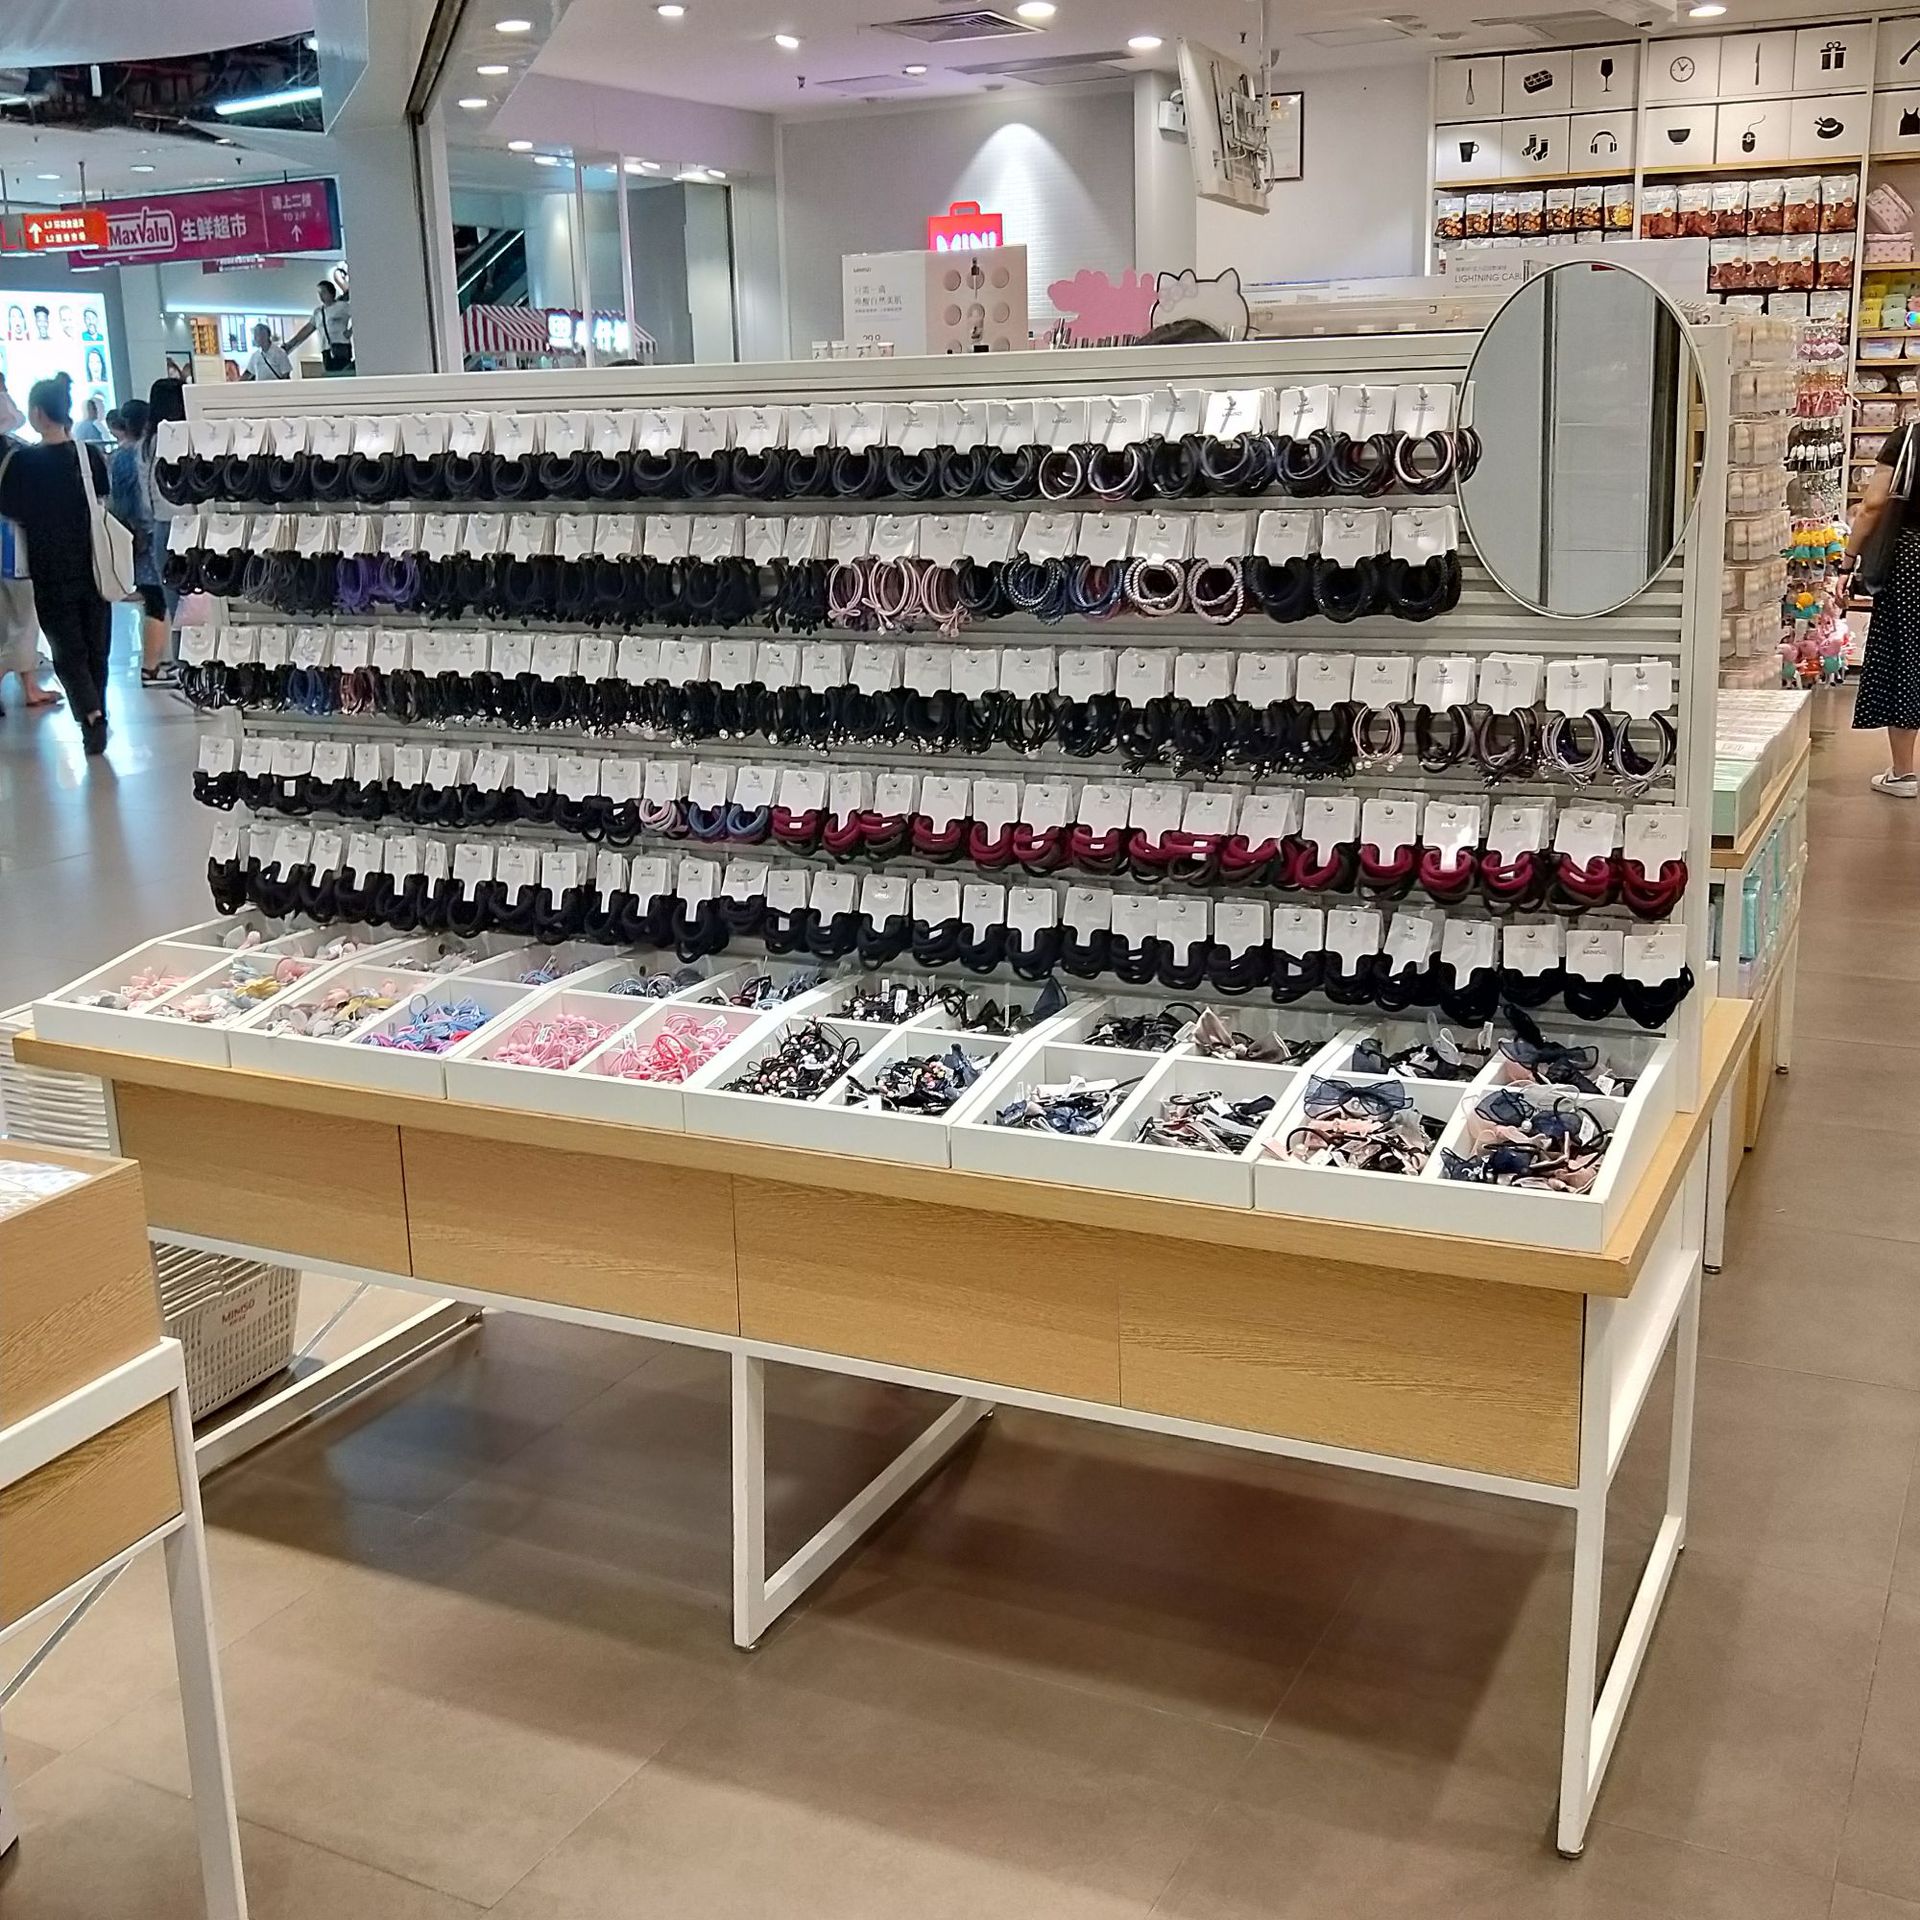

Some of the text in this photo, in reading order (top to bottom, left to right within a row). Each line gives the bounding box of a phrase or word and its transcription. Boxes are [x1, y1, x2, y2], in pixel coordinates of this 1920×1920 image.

[109, 207, 169, 246] MaxValu
[1454, 273, 1500, 284] LIGHTNING
[222, 1299, 254, 1323] MINISO
